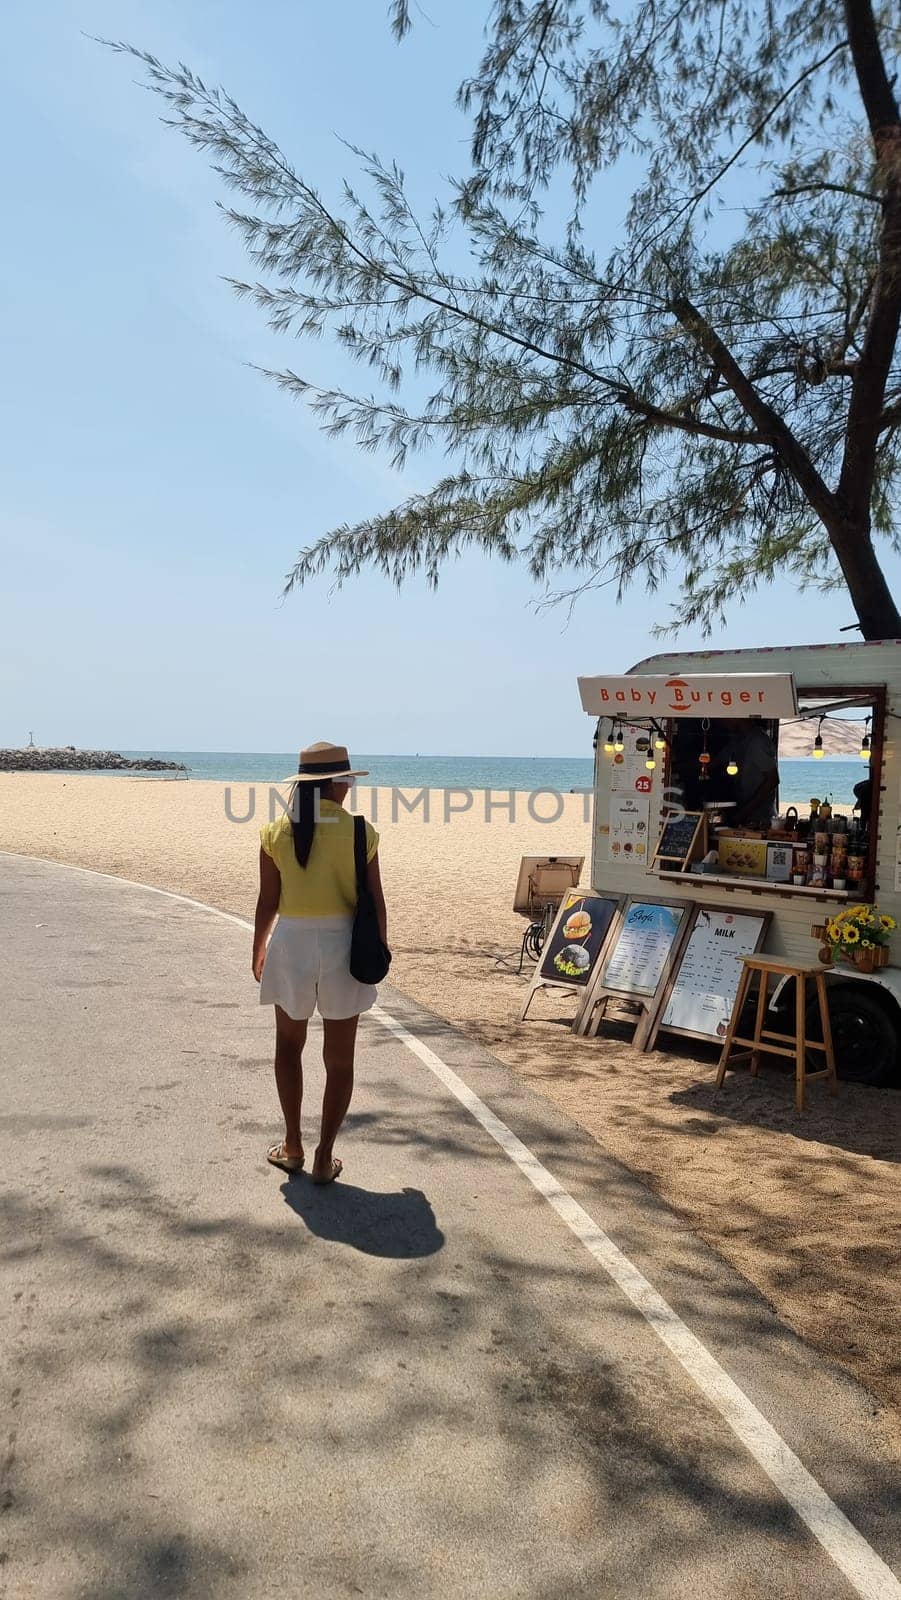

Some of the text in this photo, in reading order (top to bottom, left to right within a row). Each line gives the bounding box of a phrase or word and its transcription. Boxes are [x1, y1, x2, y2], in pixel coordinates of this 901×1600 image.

[600, 688, 765, 706] Baby Burger
[637, 781, 649, 790] 25
[714, 928, 736, 939] MILK
